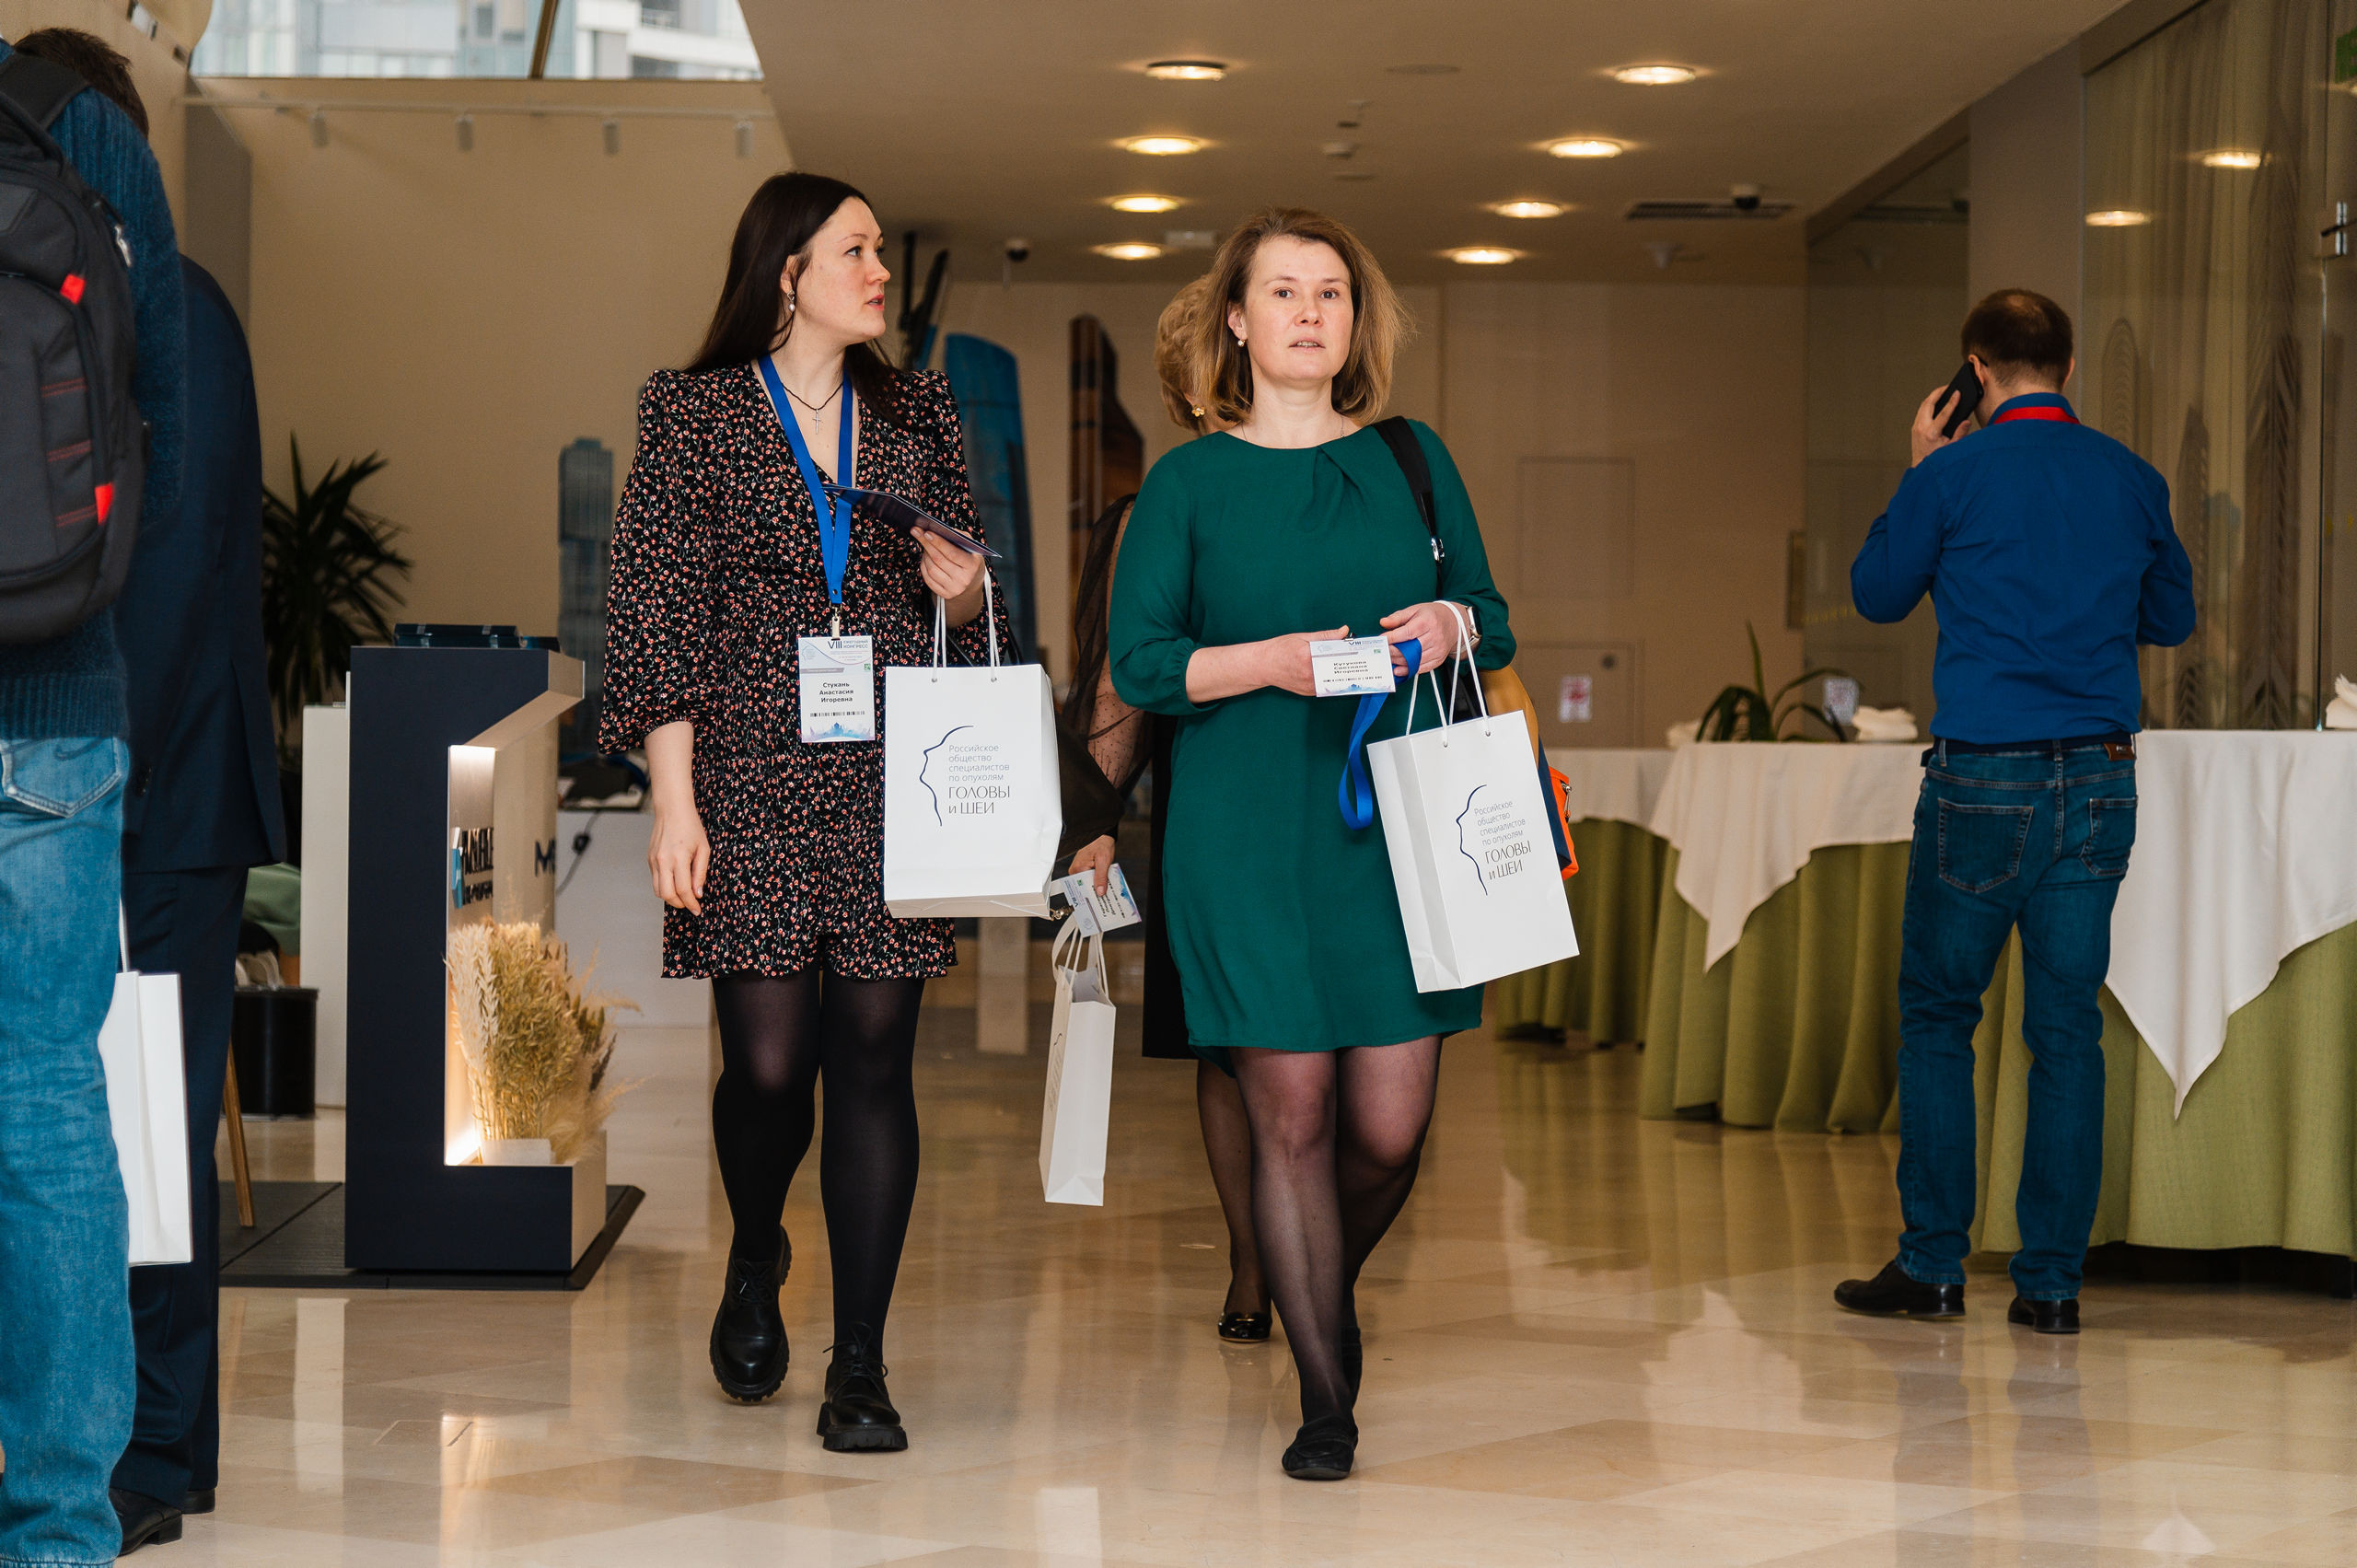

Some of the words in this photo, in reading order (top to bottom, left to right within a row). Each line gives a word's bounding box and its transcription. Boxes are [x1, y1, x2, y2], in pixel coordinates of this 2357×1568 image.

[948, 744, 999, 752] Российское
[948, 754, 992, 762] общество
[948, 764, 1010, 772] специалистов
[962, 774, 1004, 783] опухолям
[948, 785, 1010, 799] ГОЛОВЫ
[948, 805, 957, 814] и
[960, 801, 994, 814] ШЕИ
[1473, 800, 1513, 817] Российское
[1477, 812, 1510, 827] общество
[1480, 819, 1526, 837] специалистов
[1482, 838, 1492, 846] по
[1492, 830, 1523, 844] опухолям
[1485, 840, 1531, 864] ГОЛОВЫ
[1489, 870, 1496, 880] и
[1496, 859, 1523, 877] ШЕИ
